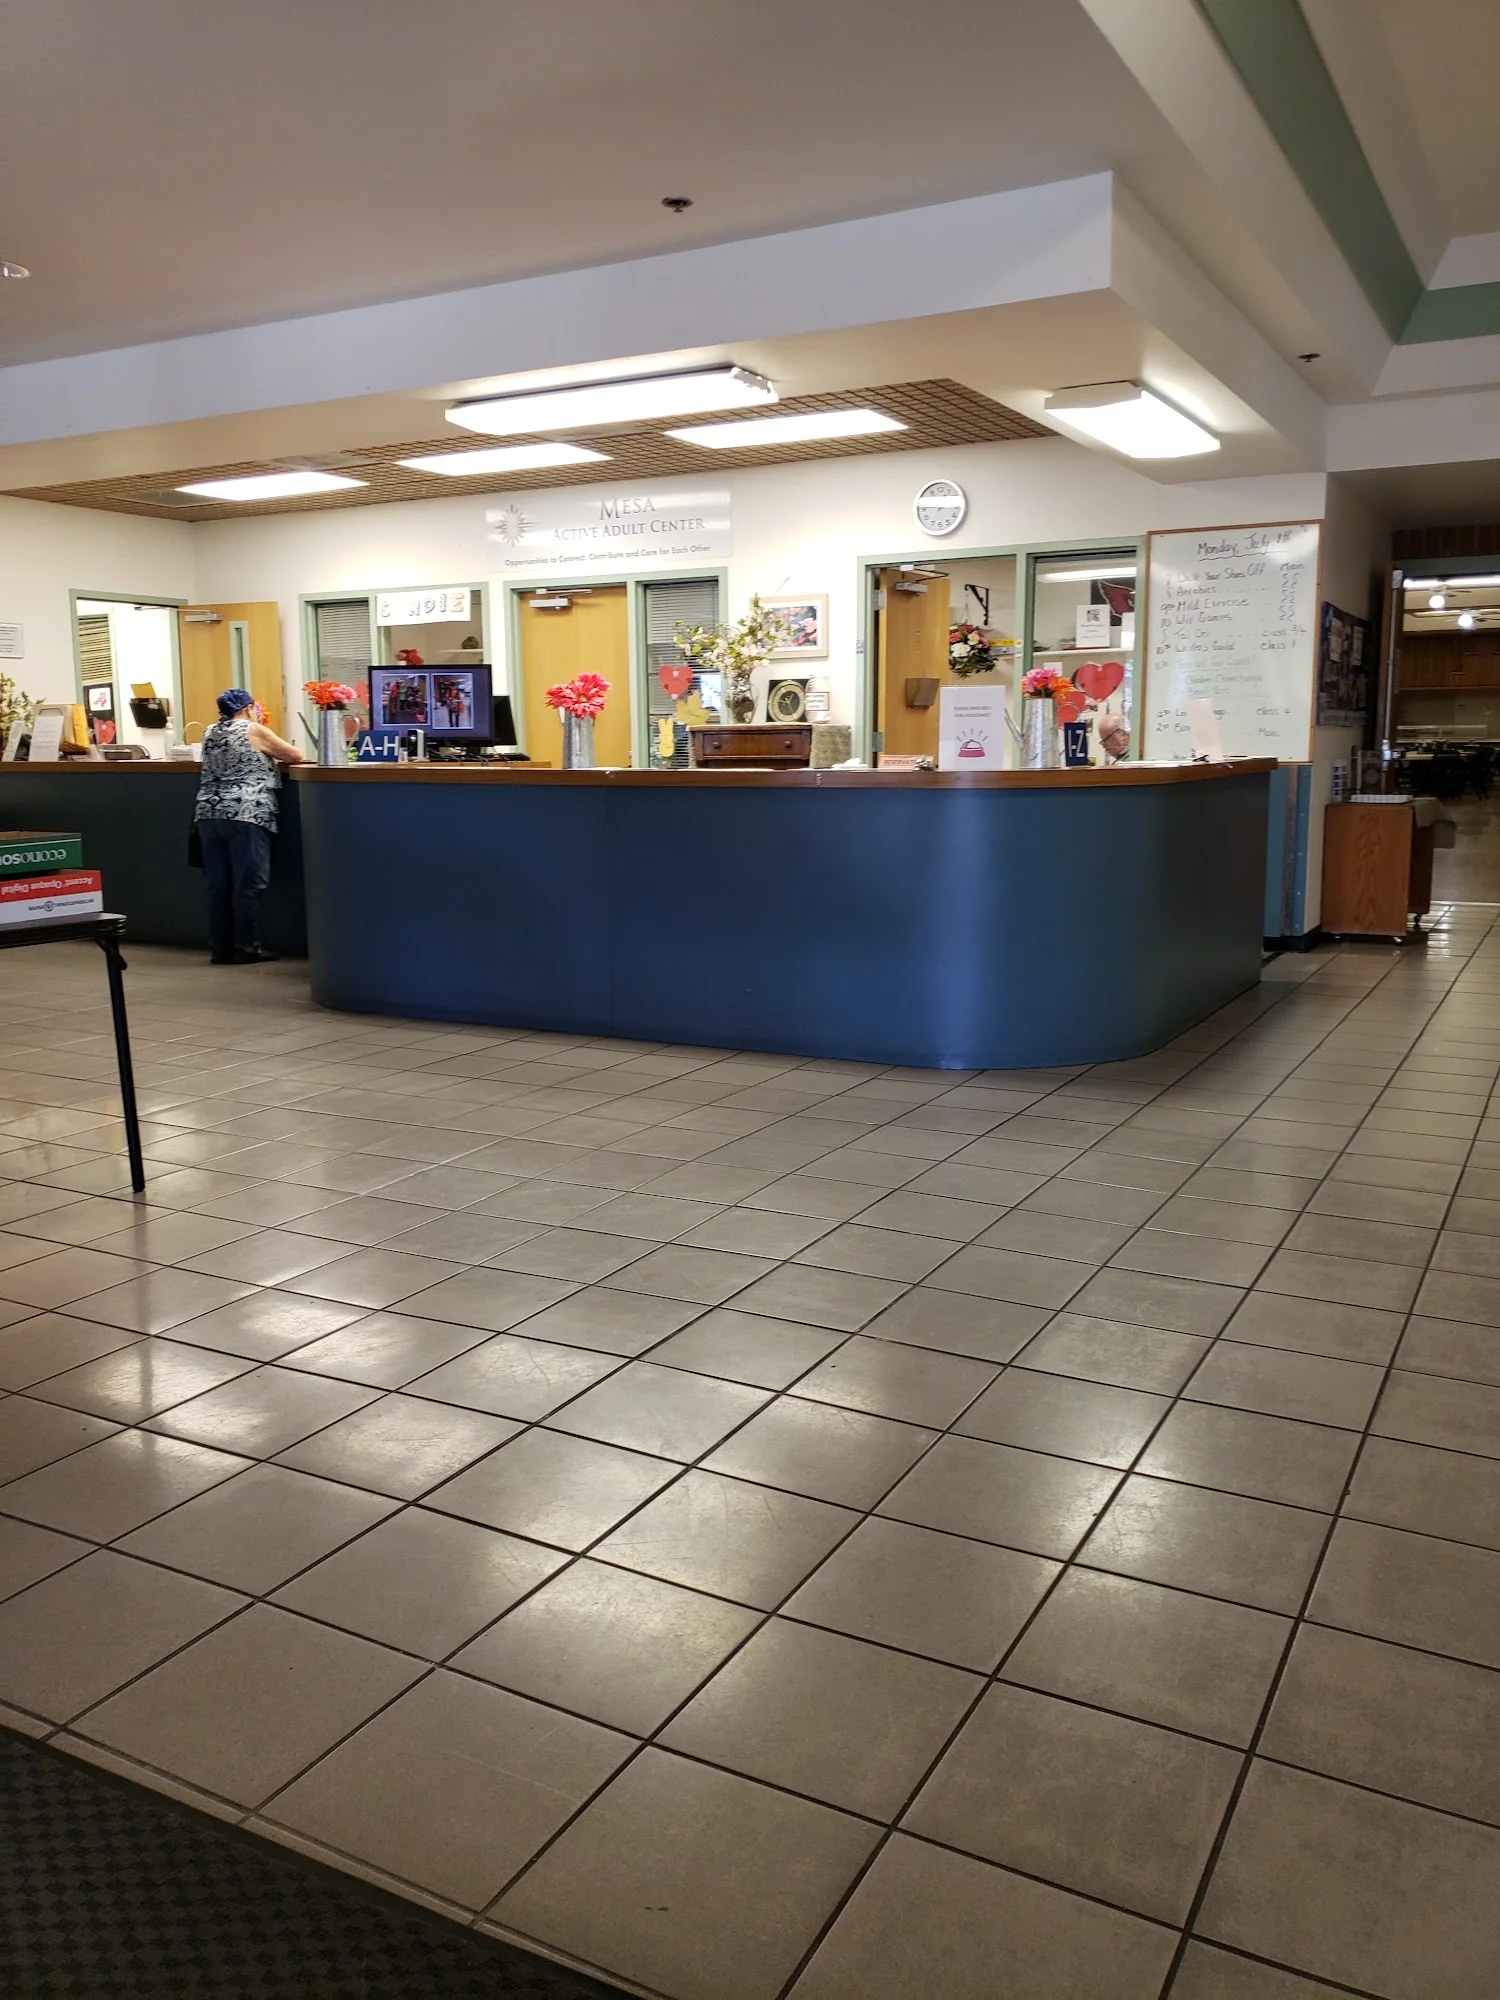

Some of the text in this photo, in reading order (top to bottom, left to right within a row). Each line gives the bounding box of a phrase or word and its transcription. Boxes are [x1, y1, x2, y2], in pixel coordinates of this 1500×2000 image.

[600, 498, 656, 520] MESA
[553, 518, 705, 542] ACTIVE ADULT CENTER
[1244, 532, 1270, 552] July
[504, 556, 549, 567] Opportunities
[550, 556, 558, 564] to
[588, 551, 624, 561] Contribute
[626, 549, 640, 558] and
[640, 548, 658, 556] Care
[658, 546, 670, 555] for
[672, 545, 688, 554] Each
[690, 544, 712, 553] Other
[1176, 600, 1200, 612] Mild
[358, 735, 400, 757] A-H
[0, 848, 67, 866] econoso
[30, 880, 62, 890] Opaque
